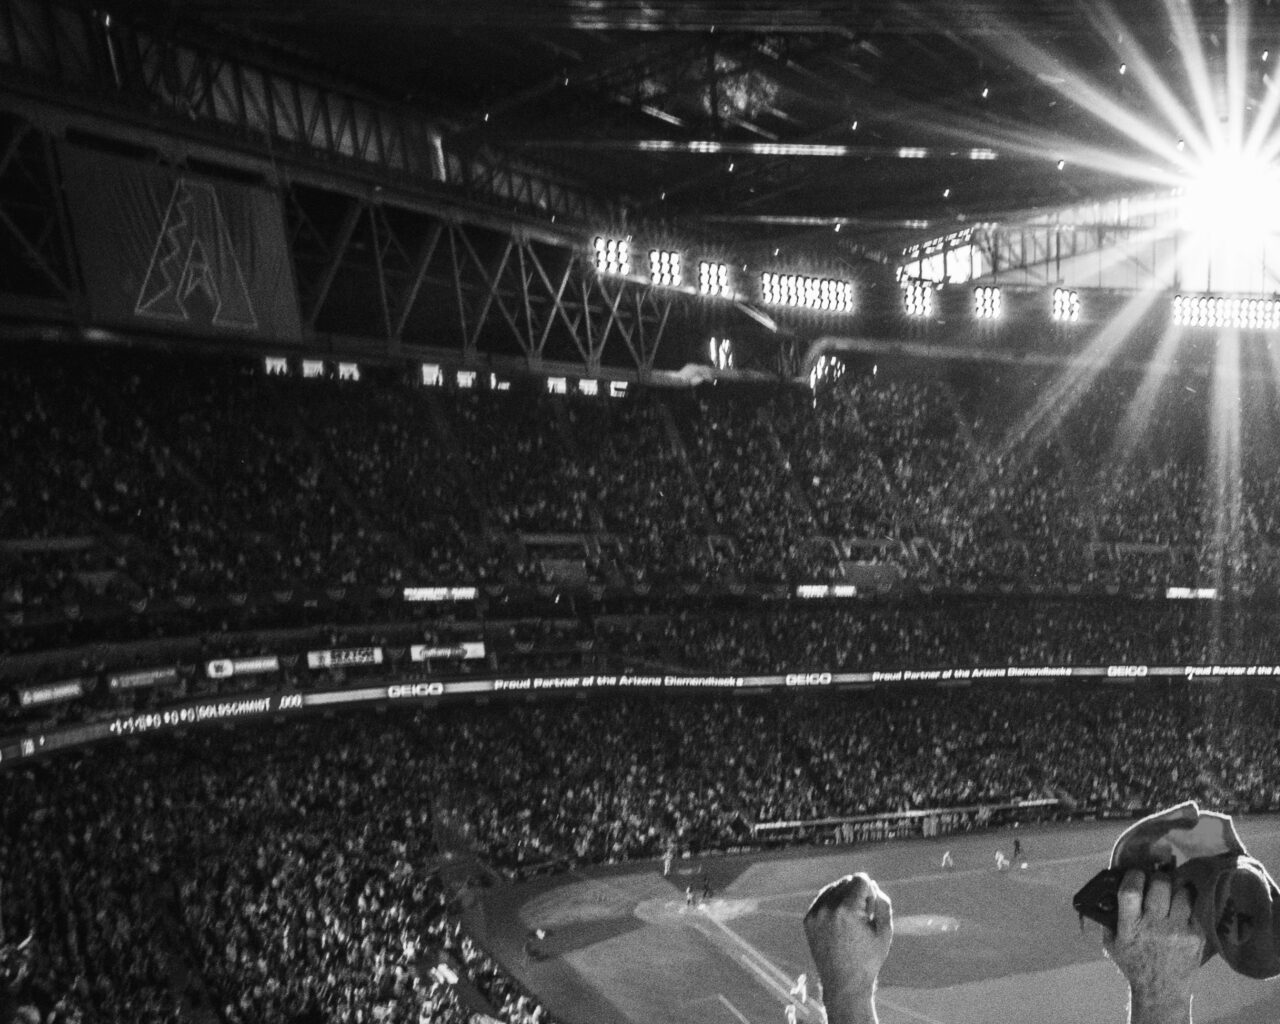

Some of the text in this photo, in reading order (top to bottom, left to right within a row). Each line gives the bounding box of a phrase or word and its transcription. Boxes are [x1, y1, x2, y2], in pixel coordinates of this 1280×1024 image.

[1107, 665, 1148, 677] GEICO
[494, 678, 531, 690] Proud
[533, 676, 580, 689] Partner
[596, 675, 617, 687] the
[619, 675, 662, 687] Arizona
[786, 672, 832, 685] GEICO
[388, 682, 443, 698] GEICO
